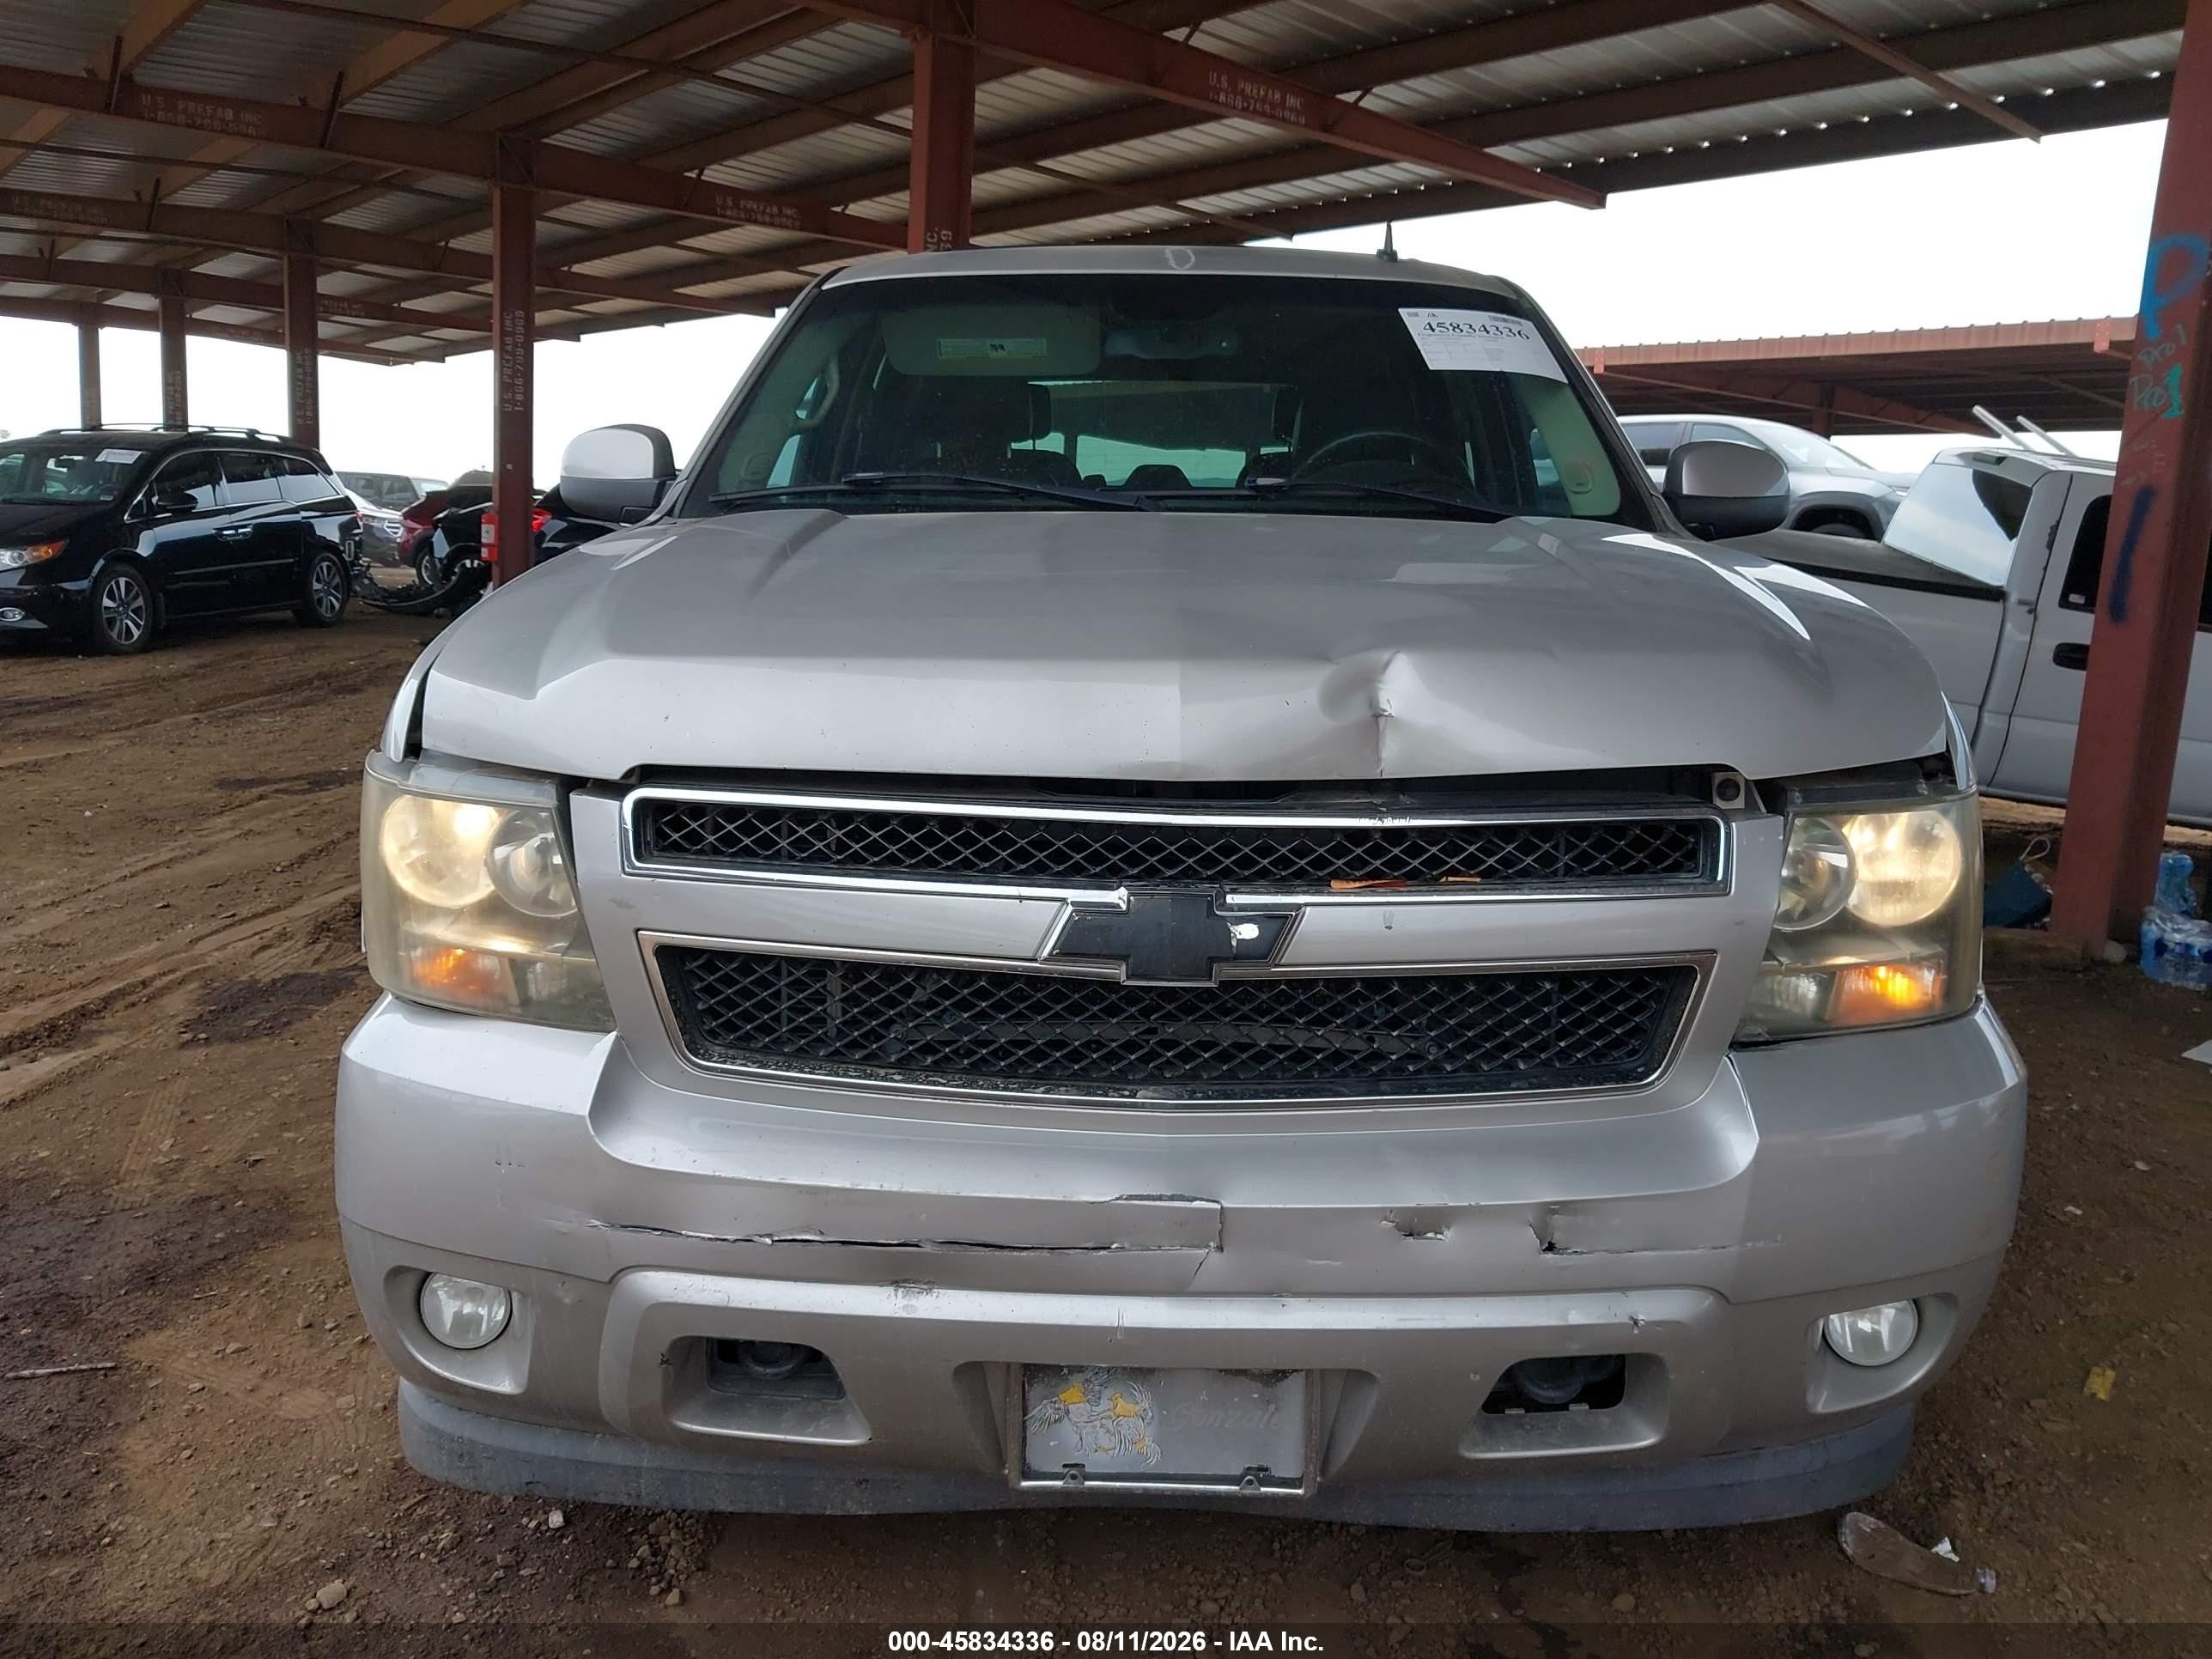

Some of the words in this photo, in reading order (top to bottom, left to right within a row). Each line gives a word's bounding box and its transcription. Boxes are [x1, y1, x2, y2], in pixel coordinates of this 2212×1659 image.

[1209, 71, 1231, 91] U.S.
[1238, 81, 1280, 103] PREFAB
[178, 100, 234, 121] PREFAB
[1422, 321, 1531, 341] 45834336
[501, 337, 514, 383] PREFAB
